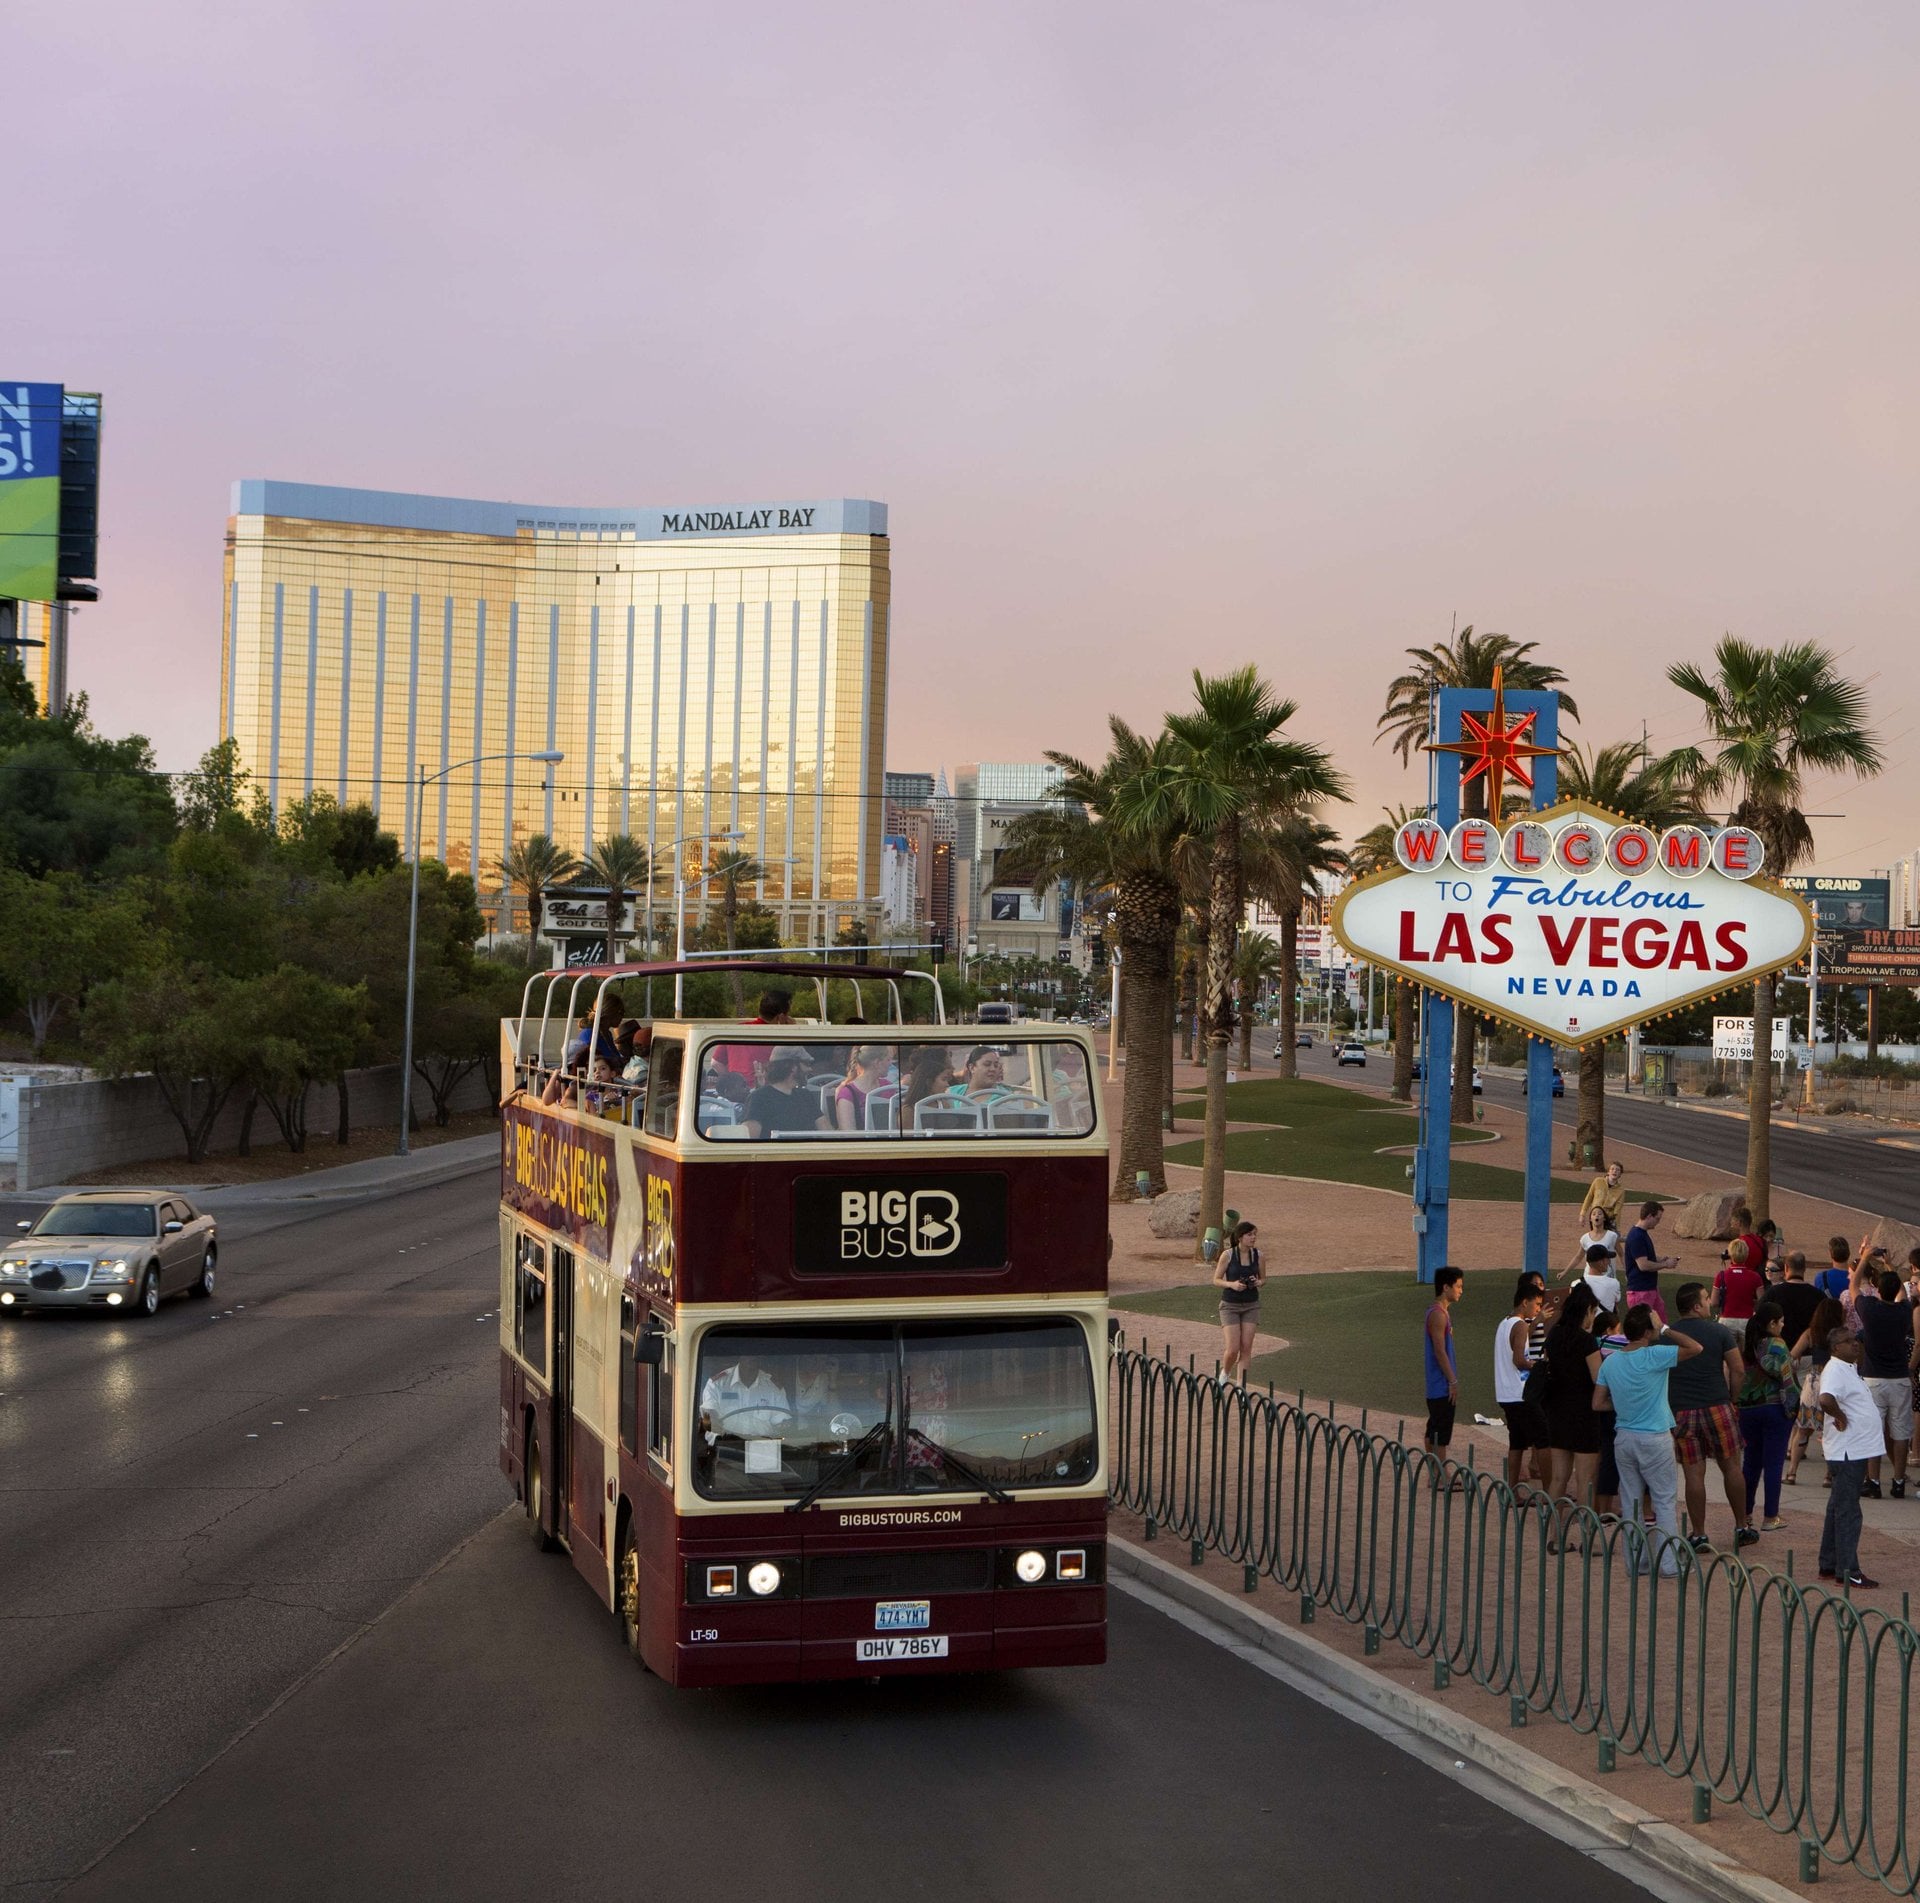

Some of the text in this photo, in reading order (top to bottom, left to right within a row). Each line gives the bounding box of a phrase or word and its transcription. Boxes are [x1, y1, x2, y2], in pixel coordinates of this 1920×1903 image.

[661, 508, 815, 533] MANDALAY BAY
[1404, 829, 1749, 869] WELCOME
[1435, 876, 1705, 909] TO Fabulous
[1815, 879, 1862, 891] GRAND
[547, 902, 588, 916] Bali
[556, 920, 587, 928] GOLF
[1399, 911, 1748, 972] LAS VEGAS
[1864, 929, 1891, 945] TRY
[1849, 953, 1868, 961] TURN
[1870, 954, 1892, 962] RIGHT
[1820, 966, 1828, 974] E.
[1830, 966, 1878, 975] TROPICANA
[1879, 967, 1898, 975] AVE.
[1899, 968, 1918, 976] (702)
[1508, 977, 1641, 998] NEVADA
[1716, 1019, 1745, 1031] FOR
[1714, 1047, 1739, 1060] (775)
[516, 1122, 532, 1188] BIG
[549, 1135, 568, 1209] LAS
[570, 1144, 607, 1228] VEGAS
[647, 1173, 662, 1225] BIG
[841, 1190, 907, 1225] BIG
[841, 1227, 907, 1259] BUS
[839, 1510, 962, 1527] BIGBUSTOURS.COM
[690, 1628, 718, 1641] LT-50
[863, 1637, 941, 1657] OHV 786Y
